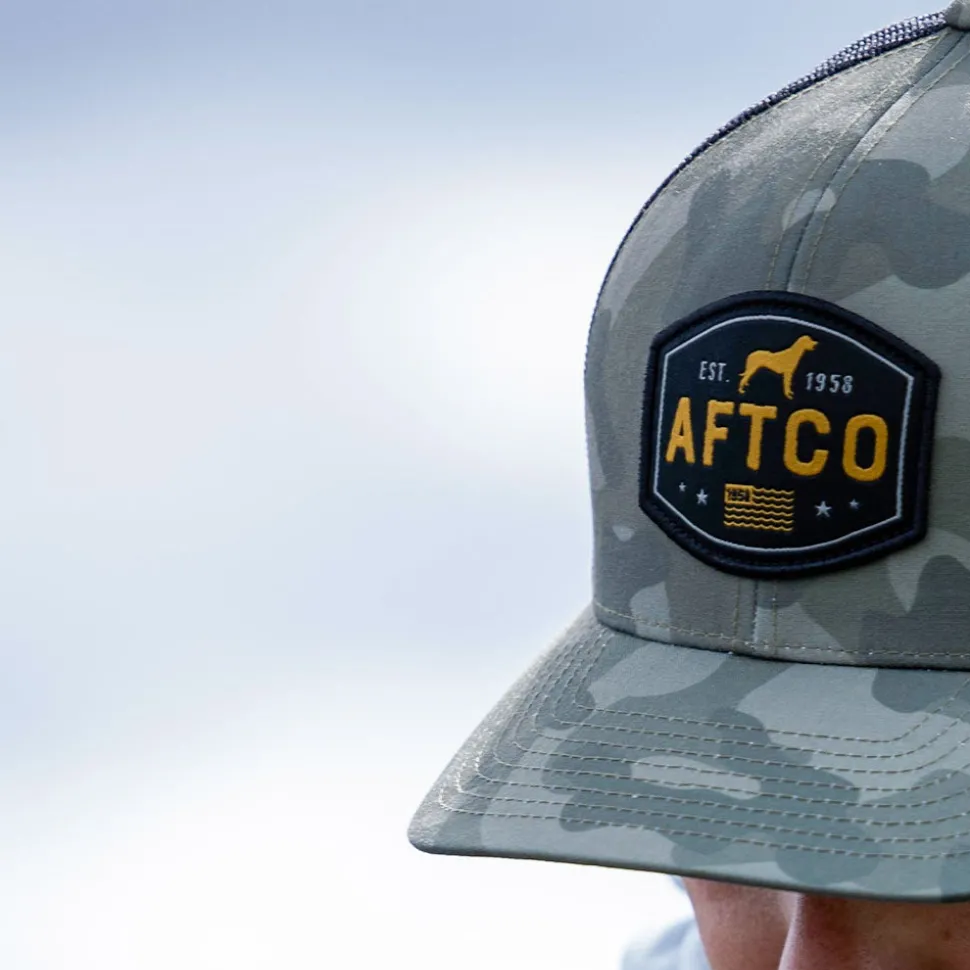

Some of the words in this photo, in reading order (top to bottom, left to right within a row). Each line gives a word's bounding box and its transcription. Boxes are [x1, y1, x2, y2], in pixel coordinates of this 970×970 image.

[699, 360, 730, 383] EST.
[804, 372, 854, 394] 1958
[664, 396, 889, 482] AFTCO
